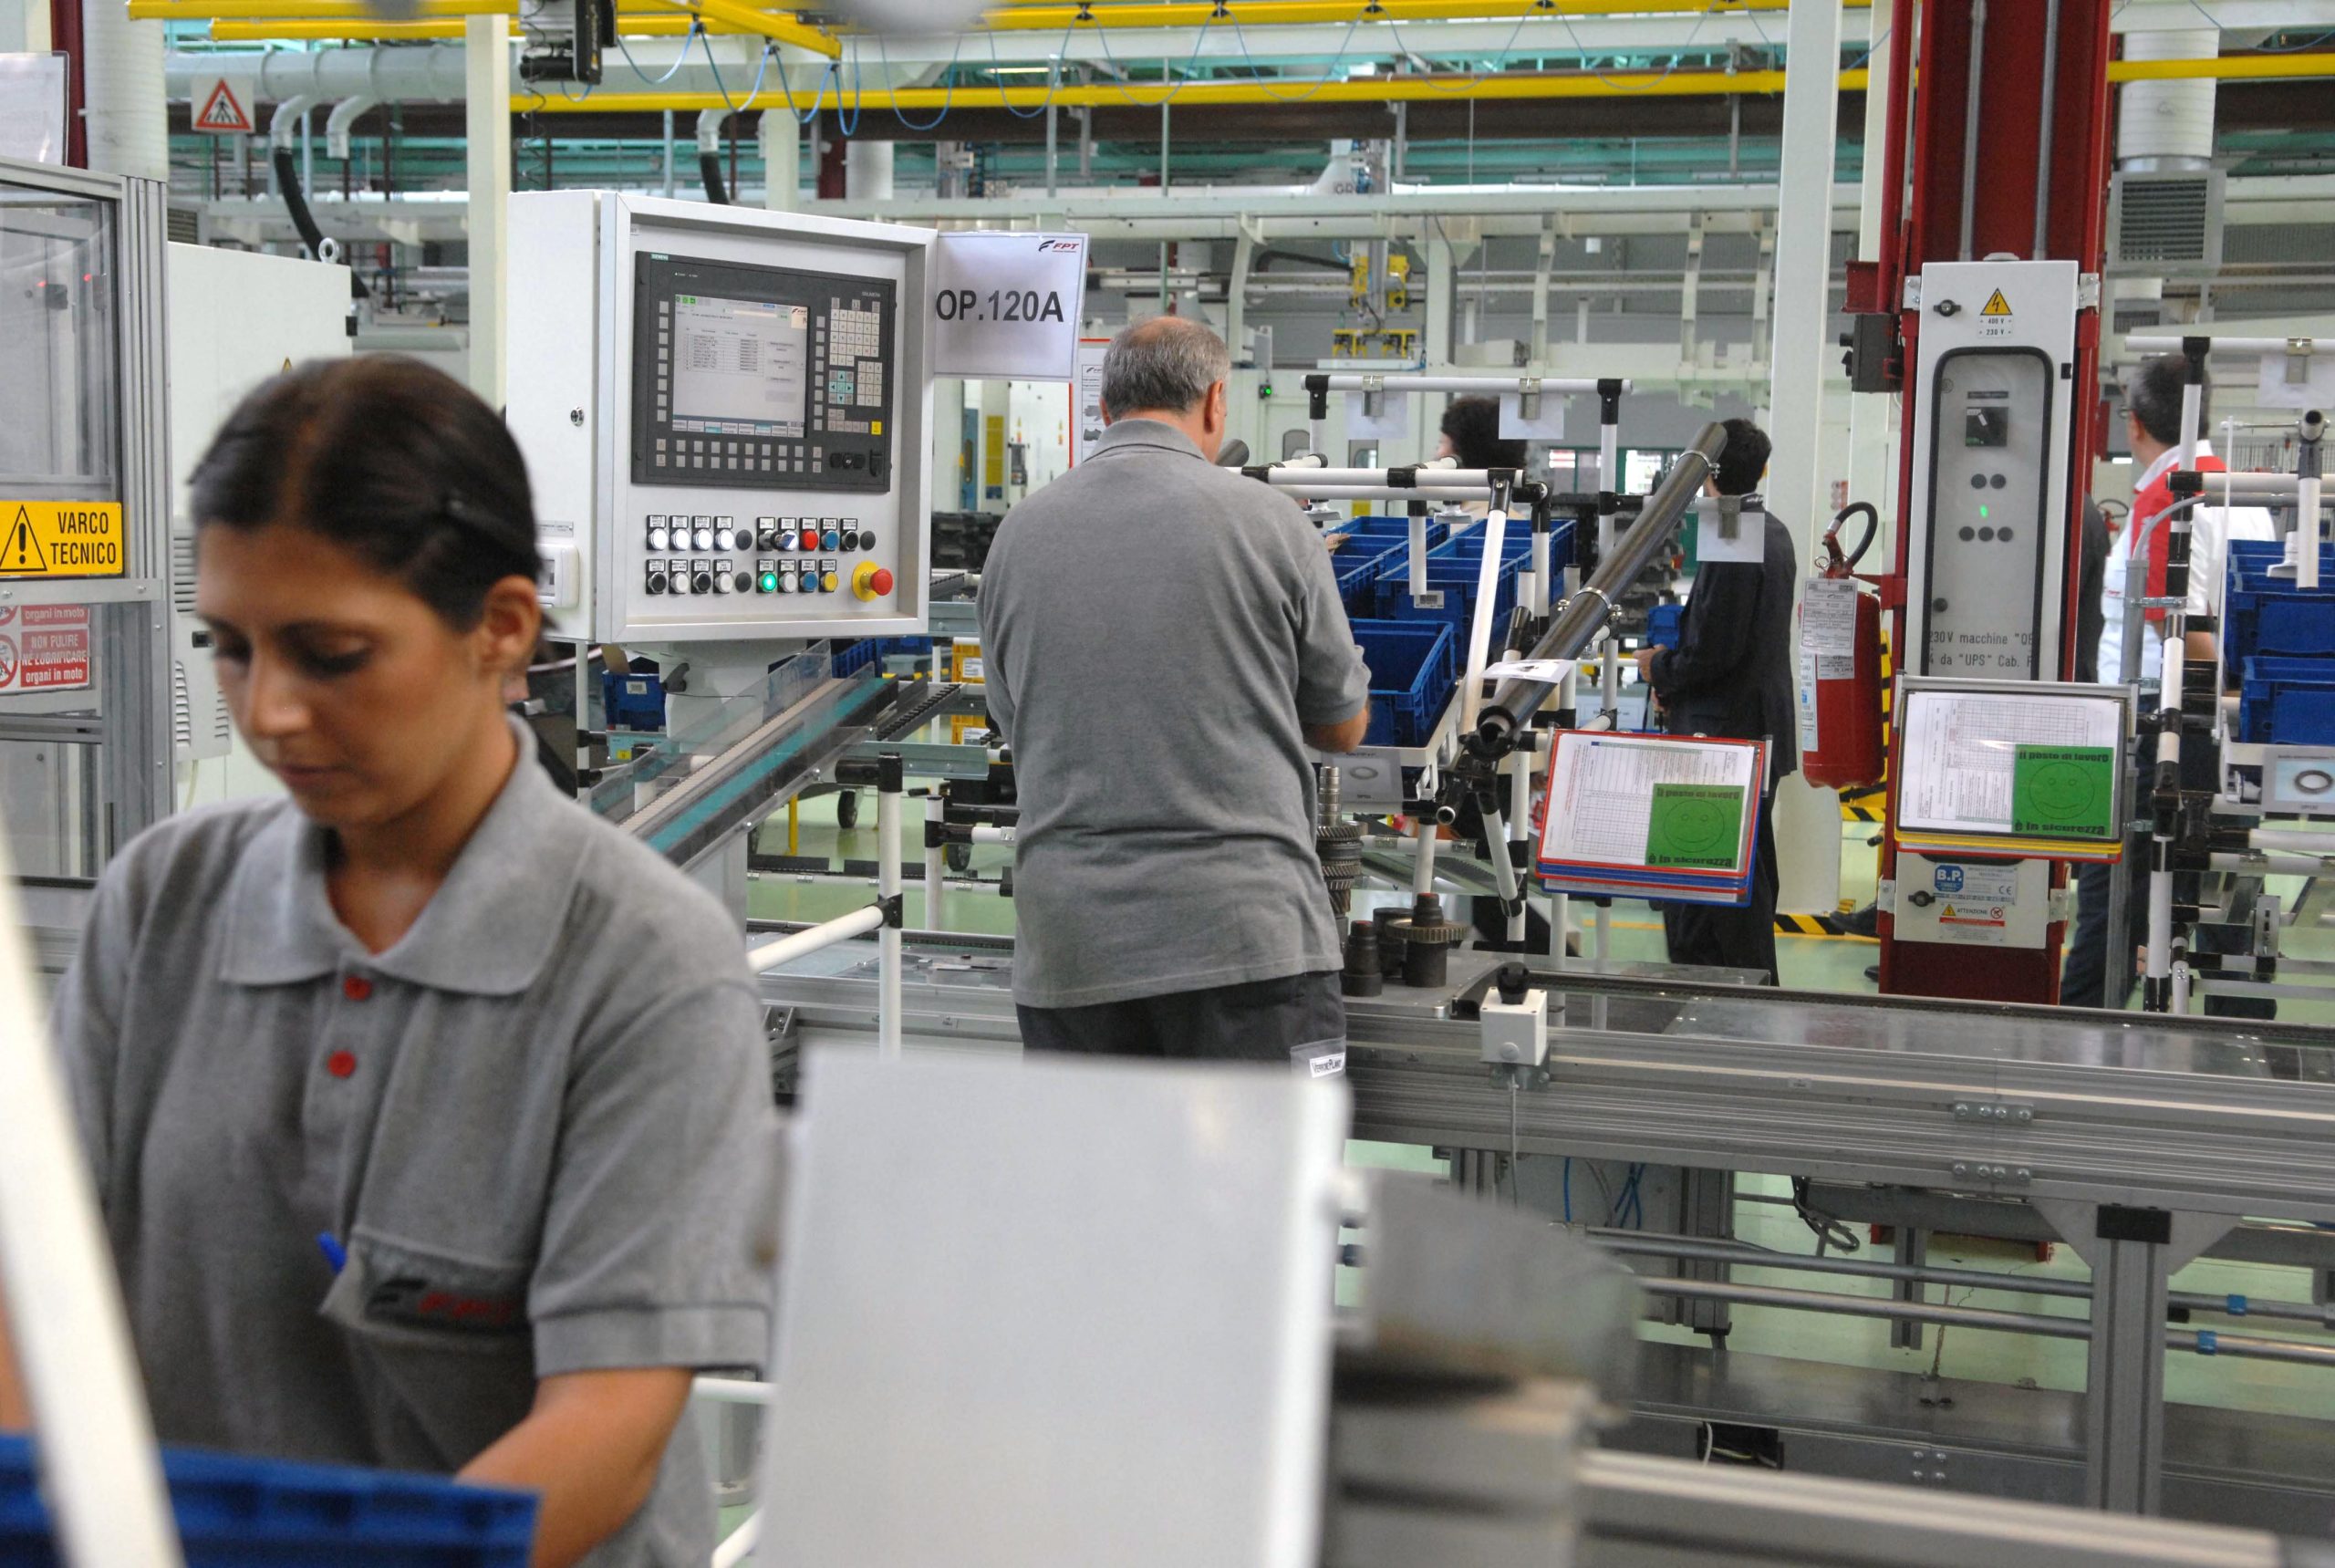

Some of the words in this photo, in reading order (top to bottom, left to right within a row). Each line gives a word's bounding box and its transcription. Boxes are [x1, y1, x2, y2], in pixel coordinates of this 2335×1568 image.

[936, 288, 1064, 323] OP.120A
[57, 512, 109, 535] VARCO
[50, 542, 117, 565] TECNICO
[26, 607, 52, 622] organi
[54, 607, 61, 618] in
[61, 607, 84, 618] moto
[31, 635, 47, 649] NON
[50, 634, 78, 648] PULIRE
[1959, 632, 2008, 645] macchine
[35, 650, 87, 665] LUBRIFICARE
[1940, 653, 1953, 665] da
[1998, 655, 2019, 668] Cab.
[26, 669, 51, 684] organi
[54, 668, 61, 680] in
[64, 667, 83, 680] moto
[2029, 752, 2059, 761] posto
[2075, 753, 2109, 763] lavoro
[2027, 822, 2039, 831] in
[2041, 823, 2105, 836] sicurezza
[1659, 855, 1671, 863] in
[1674, 857, 1732, 867] sicurezza
[1936, 868, 1963, 882] B.P.
